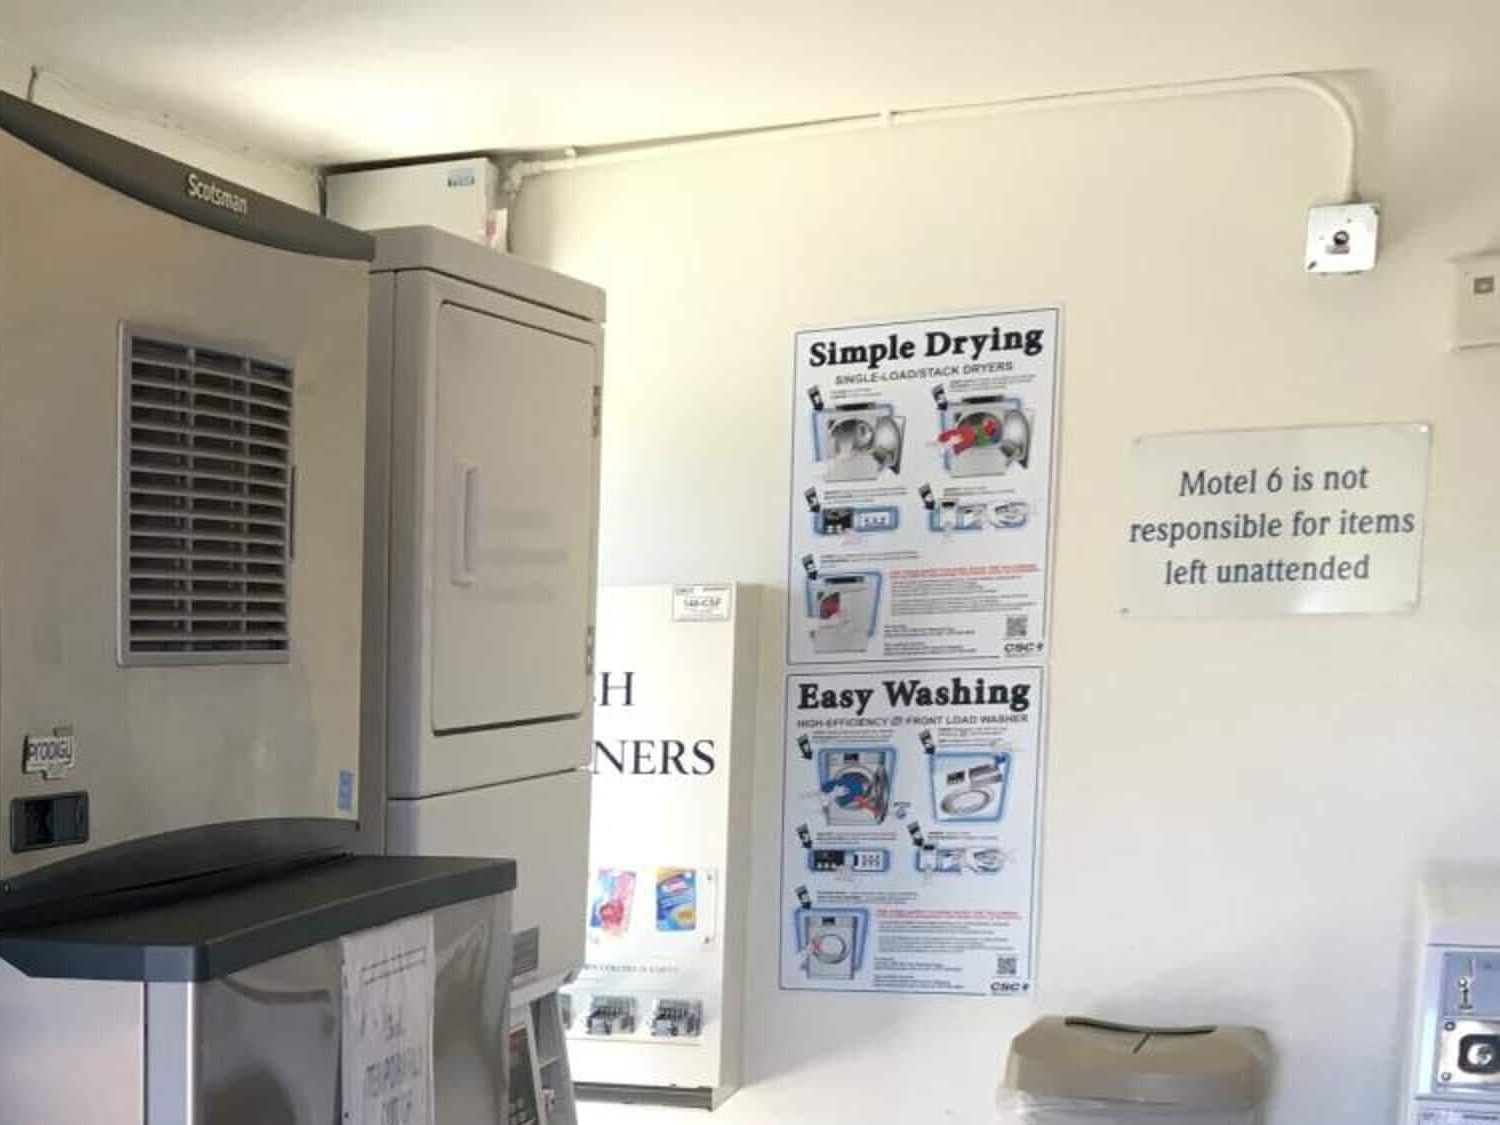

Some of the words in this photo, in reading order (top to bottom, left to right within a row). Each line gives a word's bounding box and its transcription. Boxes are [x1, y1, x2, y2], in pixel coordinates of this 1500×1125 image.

[187, 173, 248, 214] Scotsman
[809, 334, 915, 369] Simple
[925, 326, 1044, 360] Drying
[963, 361, 1013, 374] DRYERS
[1179, 468, 1257, 496] Motel
[1267, 468, 1283, 492] 6
[1292, 466, 1313, 492] is
[1324, 466, 1369, 490] not
[1129, 513, 1283, 548] responsible
[1293, 511, 1331, 537] for
[1340, 509, 1415, 535] items
[1164, 558, 1206, 586] left
[1217, 555, 1370, 584] unattended
[798, 683, 874, 715] Easy
[883, 678, 1031, 712] Washing
[906, 716, 943, 726] FRONT
[946, 715, 978, 725] LOAD
[981, 714, 1029, 724] WASHER
[593, 739, 716, 775] NERS
